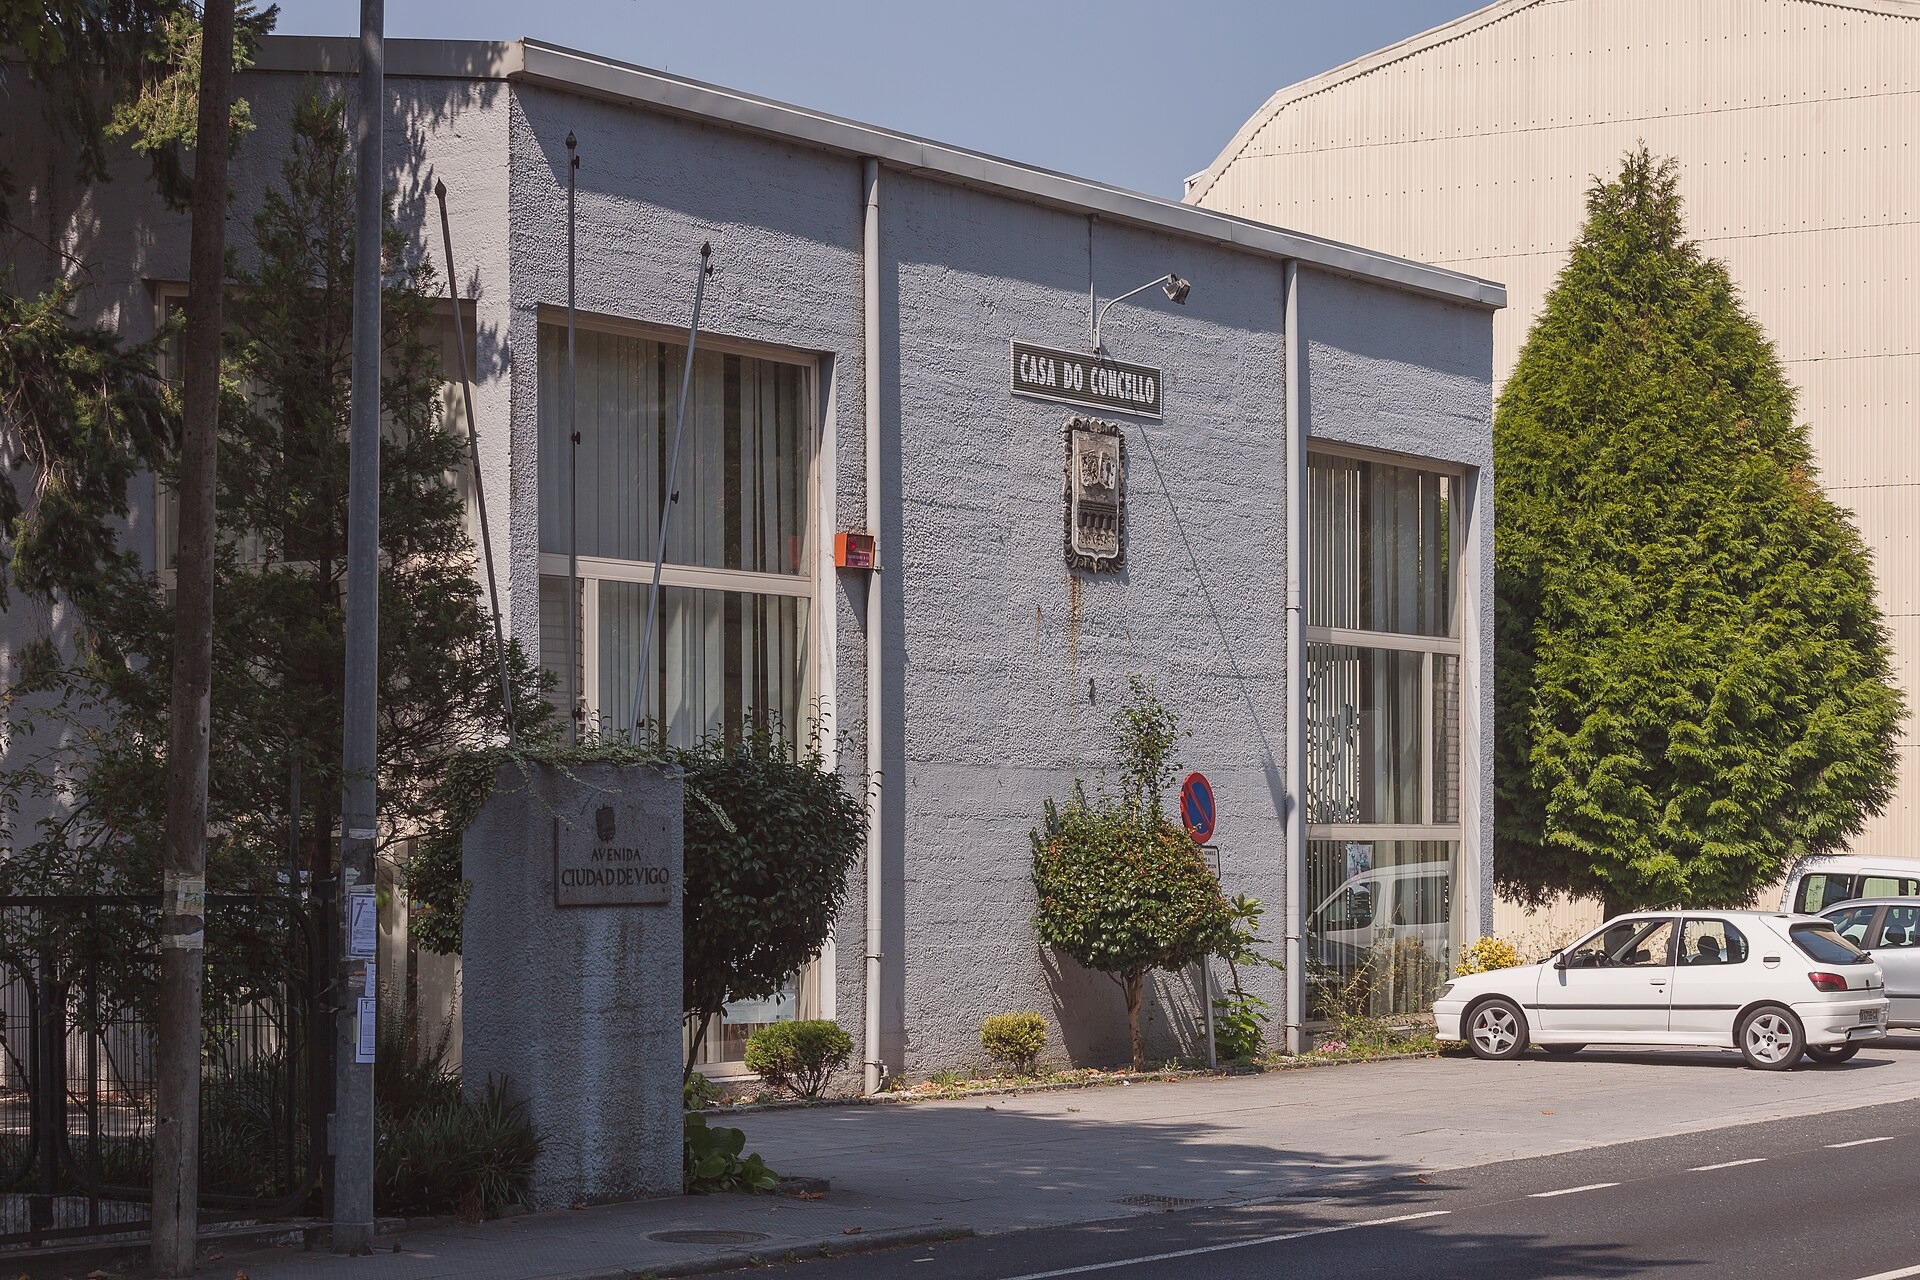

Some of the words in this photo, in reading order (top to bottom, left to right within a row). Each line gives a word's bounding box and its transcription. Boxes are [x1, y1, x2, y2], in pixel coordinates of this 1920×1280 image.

[1020, 353, 1056, 387] CASA
[1063, 361, 1083, 391] DO
[1090, 366, 1155, 404] CONCELLO
[591, 848, 641, 861] AVENIDA
[561, 868, 615, 886] CIUDAD
[617, 868, 633, 885] DE
[634, 867, 670, 885] VIGO
